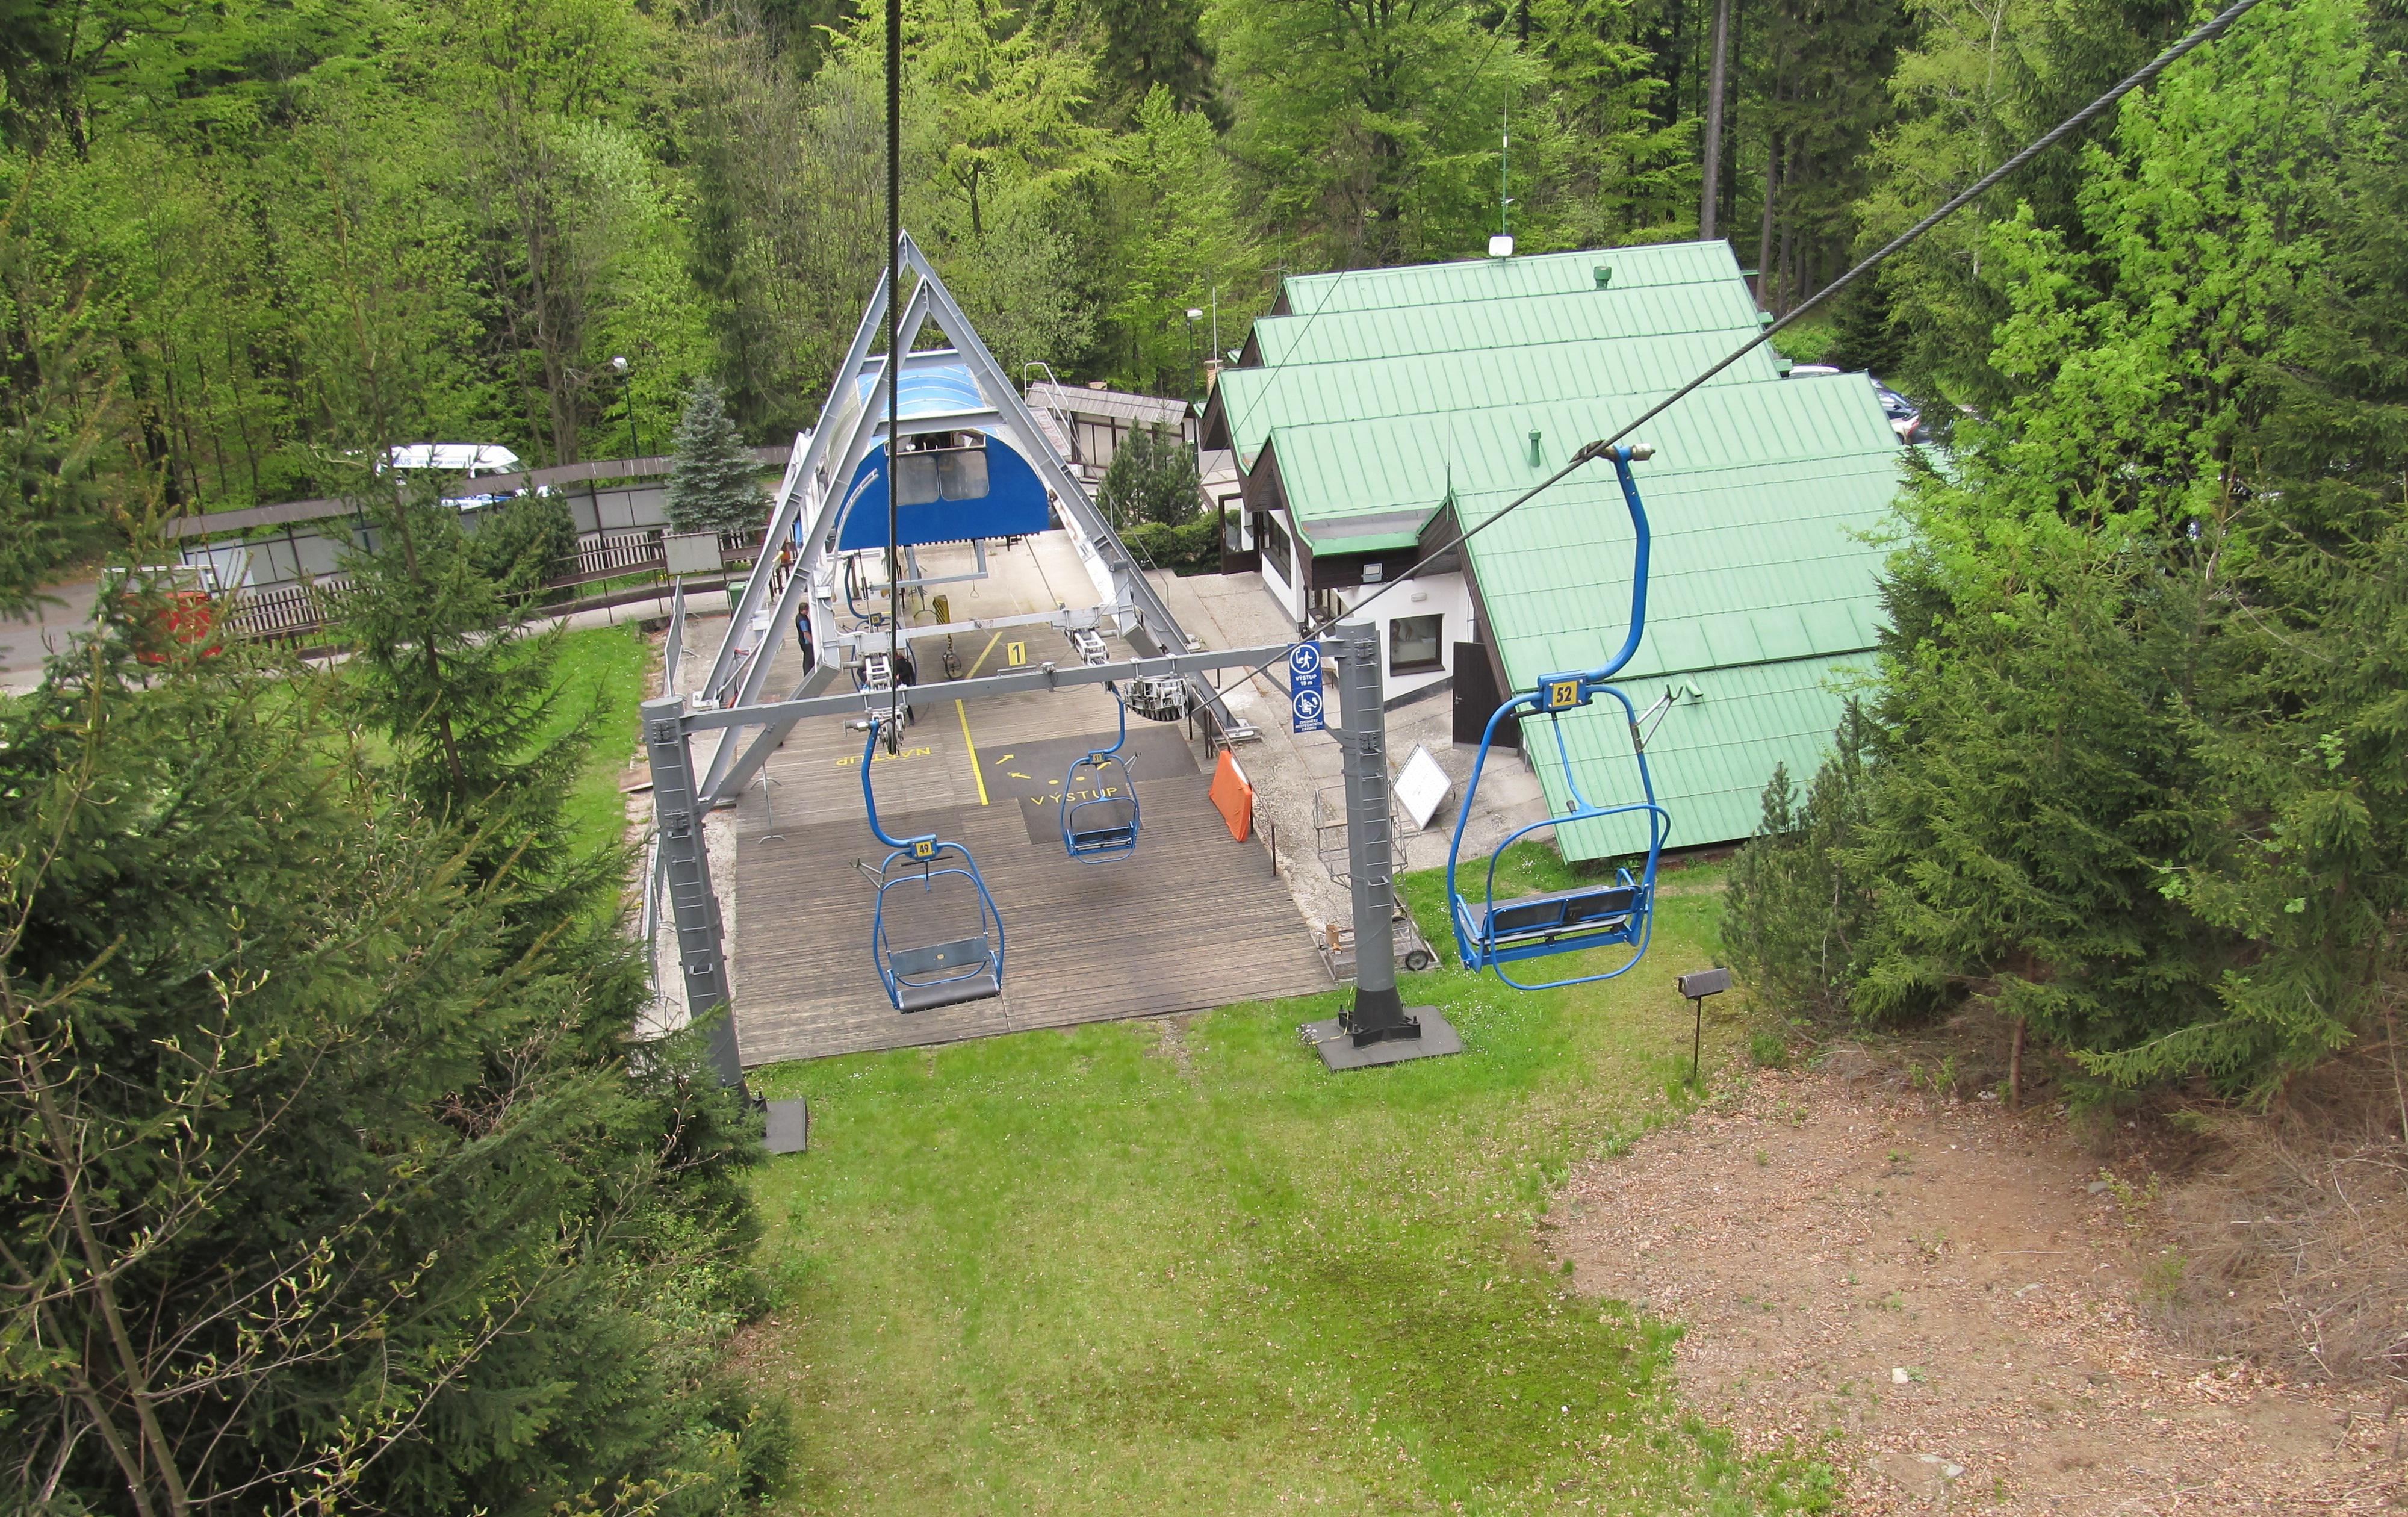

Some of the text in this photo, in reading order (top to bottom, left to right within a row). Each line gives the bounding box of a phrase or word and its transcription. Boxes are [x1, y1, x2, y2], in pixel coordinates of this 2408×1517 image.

[1012, 644, 1020, 663] 1
[1556, 686, 1571, 703] 52
[1030, 787, 1117, 805] VÝSTUP
[919, 843, 929, 854] 49
